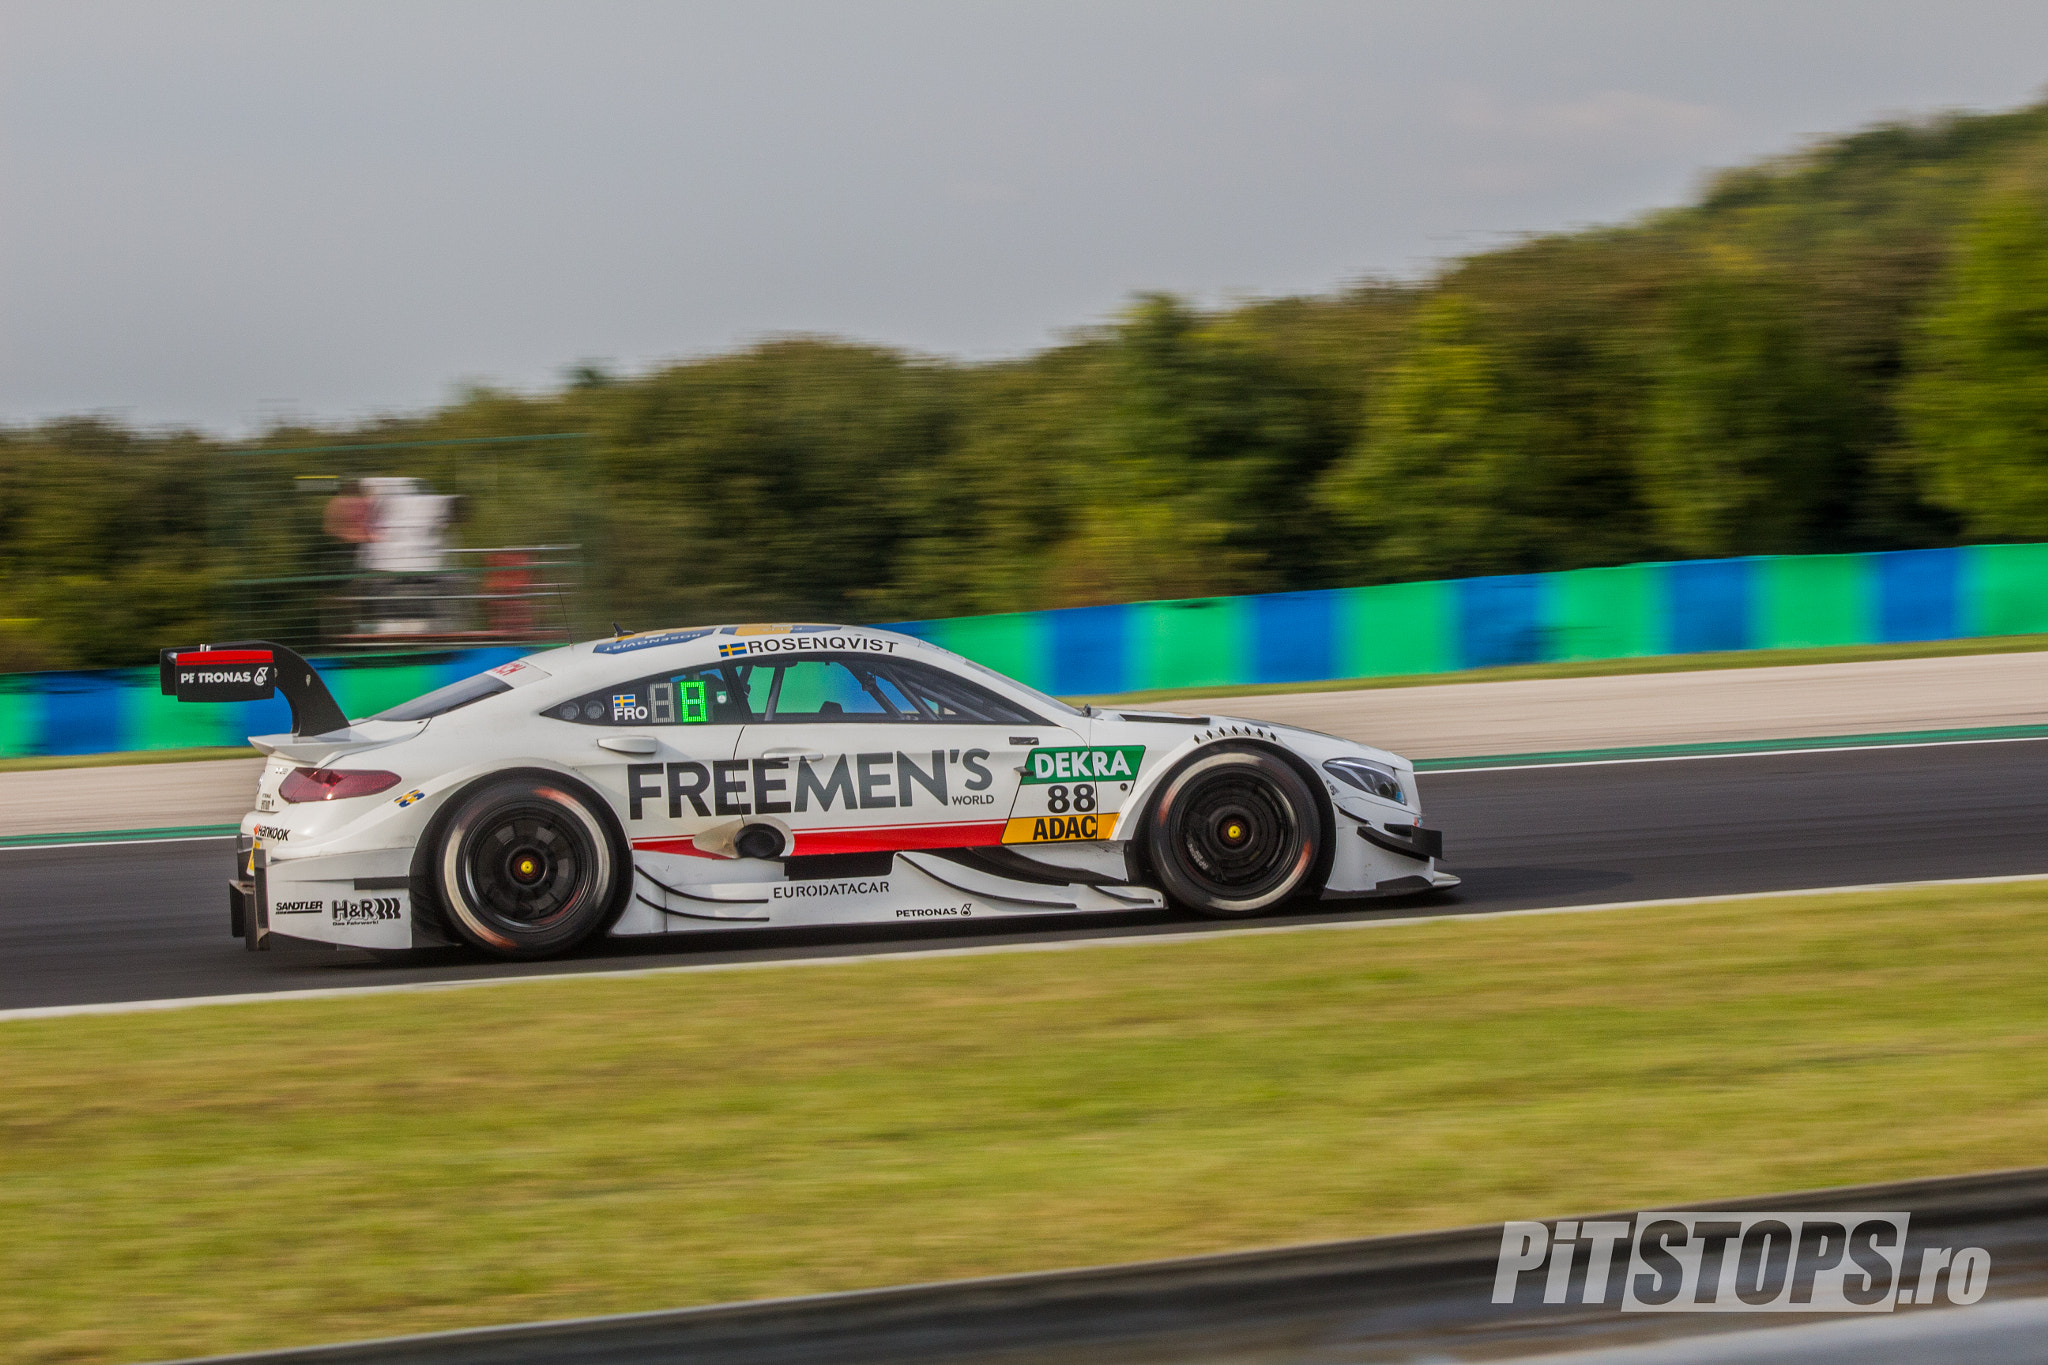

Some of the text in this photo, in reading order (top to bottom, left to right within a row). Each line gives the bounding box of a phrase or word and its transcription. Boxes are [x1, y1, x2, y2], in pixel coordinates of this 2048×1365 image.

[748, 636, 899, 654] ROSENQVIST
[613, 706, 648, 721] FRO
[1034, 750, 1132, 779] DEKRA
[627, 748, 993, 820] FREEMEN'S
[952, 794, 995, 806] WORLD
[1047, 784, 1096, 813] 88
[1032, 815, 1098, 841] ADAC
[773, 881, 890, 899] EURODATACAR
[275, 900, 323, 911] SANDTLER
[332, 899, 377, 920] H&R
[896, 907, 958, 918] PETRONAS
